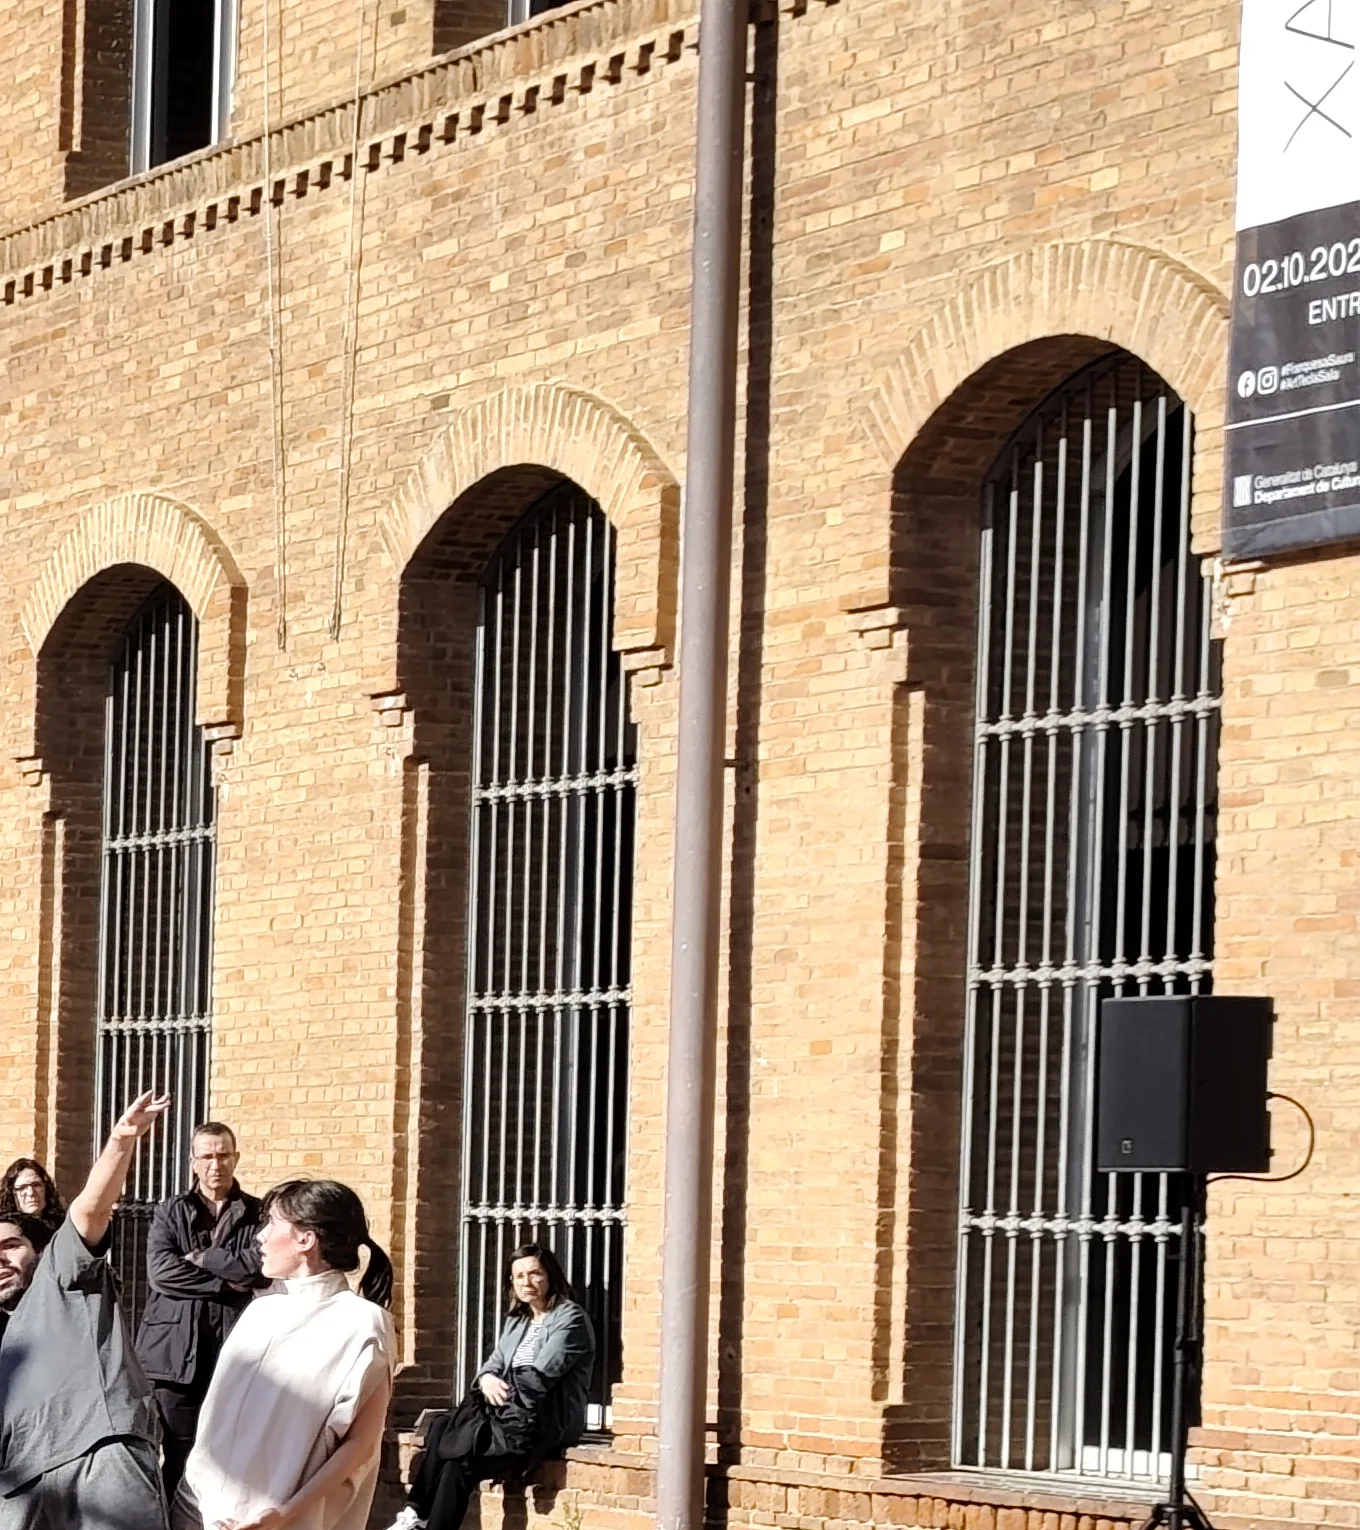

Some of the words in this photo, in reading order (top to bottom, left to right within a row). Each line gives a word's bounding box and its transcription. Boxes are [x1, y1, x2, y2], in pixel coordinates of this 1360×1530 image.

[1254, 471, 1301, 489] Generalitat
[1302, 468, 1313, 481] de
[1314, 461, 1358, 480] Catalunya
[1254, 482, 1315, 505] Departament
[1316, 479, 1330, 493] de
[1332, 475, 1360, 491] Cultur
